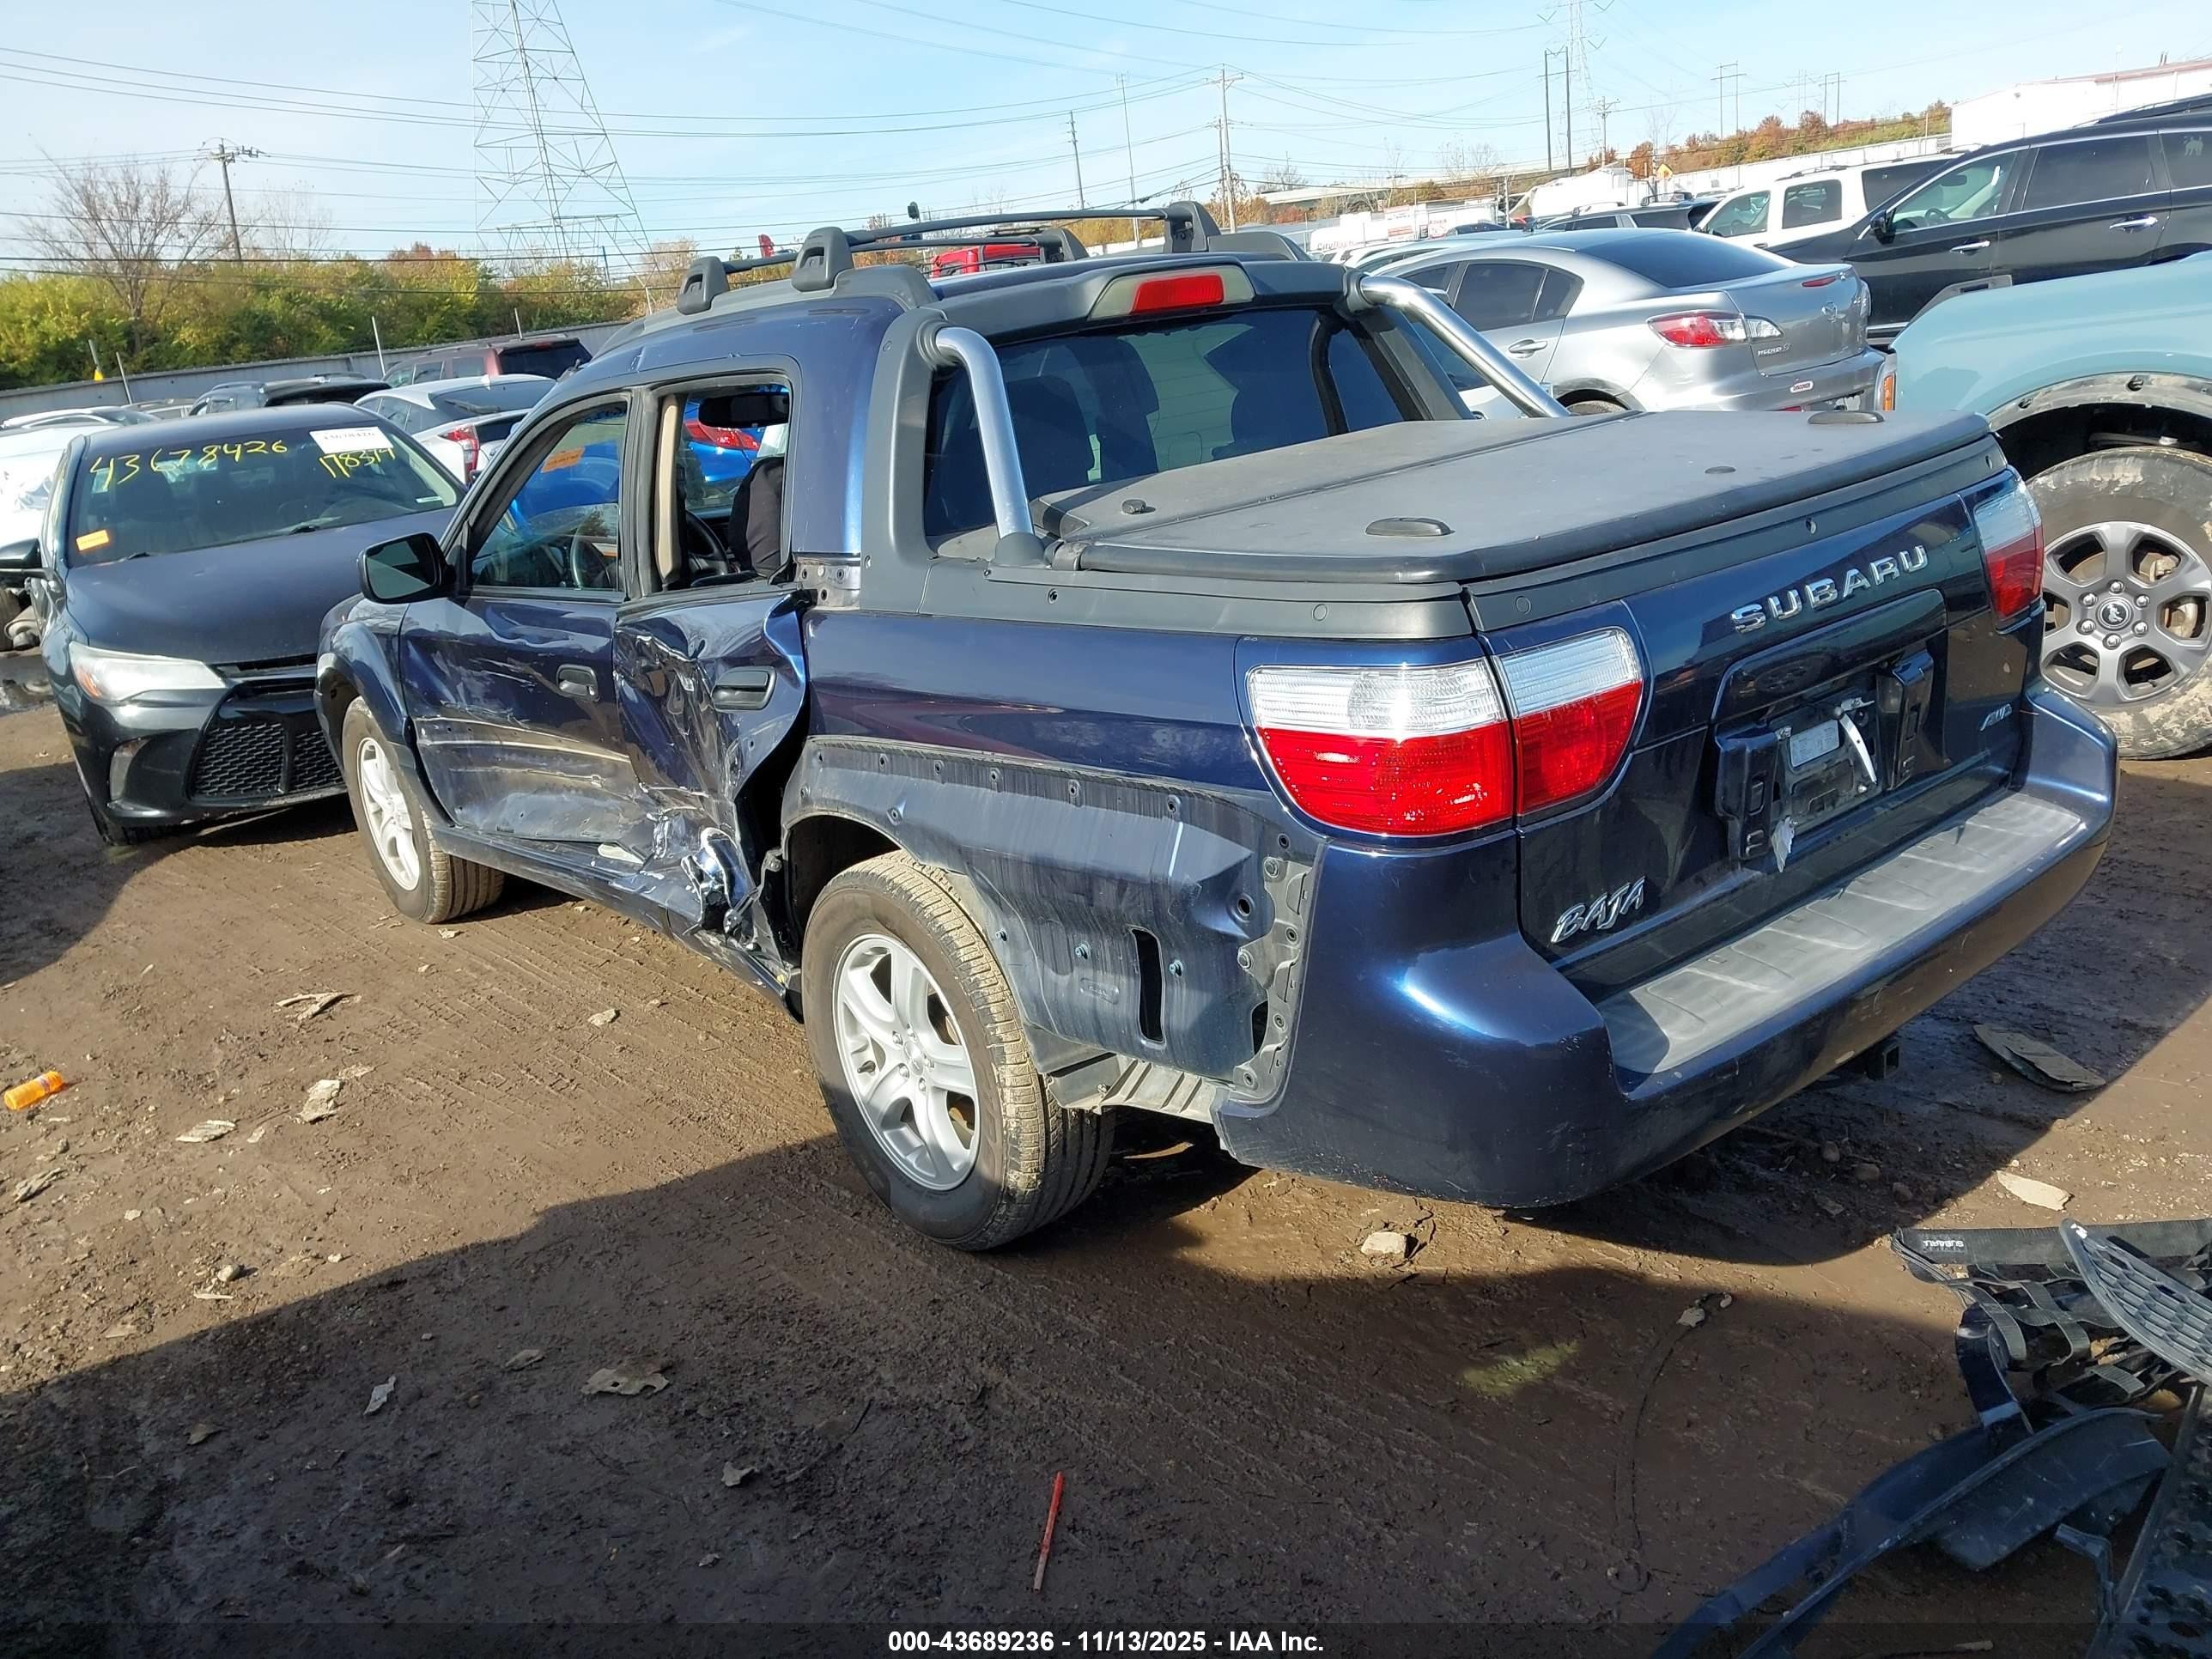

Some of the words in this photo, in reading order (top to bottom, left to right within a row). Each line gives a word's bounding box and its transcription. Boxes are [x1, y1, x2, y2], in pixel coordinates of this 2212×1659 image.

[90, 440, 287, 485] 43678426
[1731, 544, 1929, 634] SUBARU
[1551, 876, 1645, 943] BAJA
[1923, 1239, 1965, 1248] SUBARU
